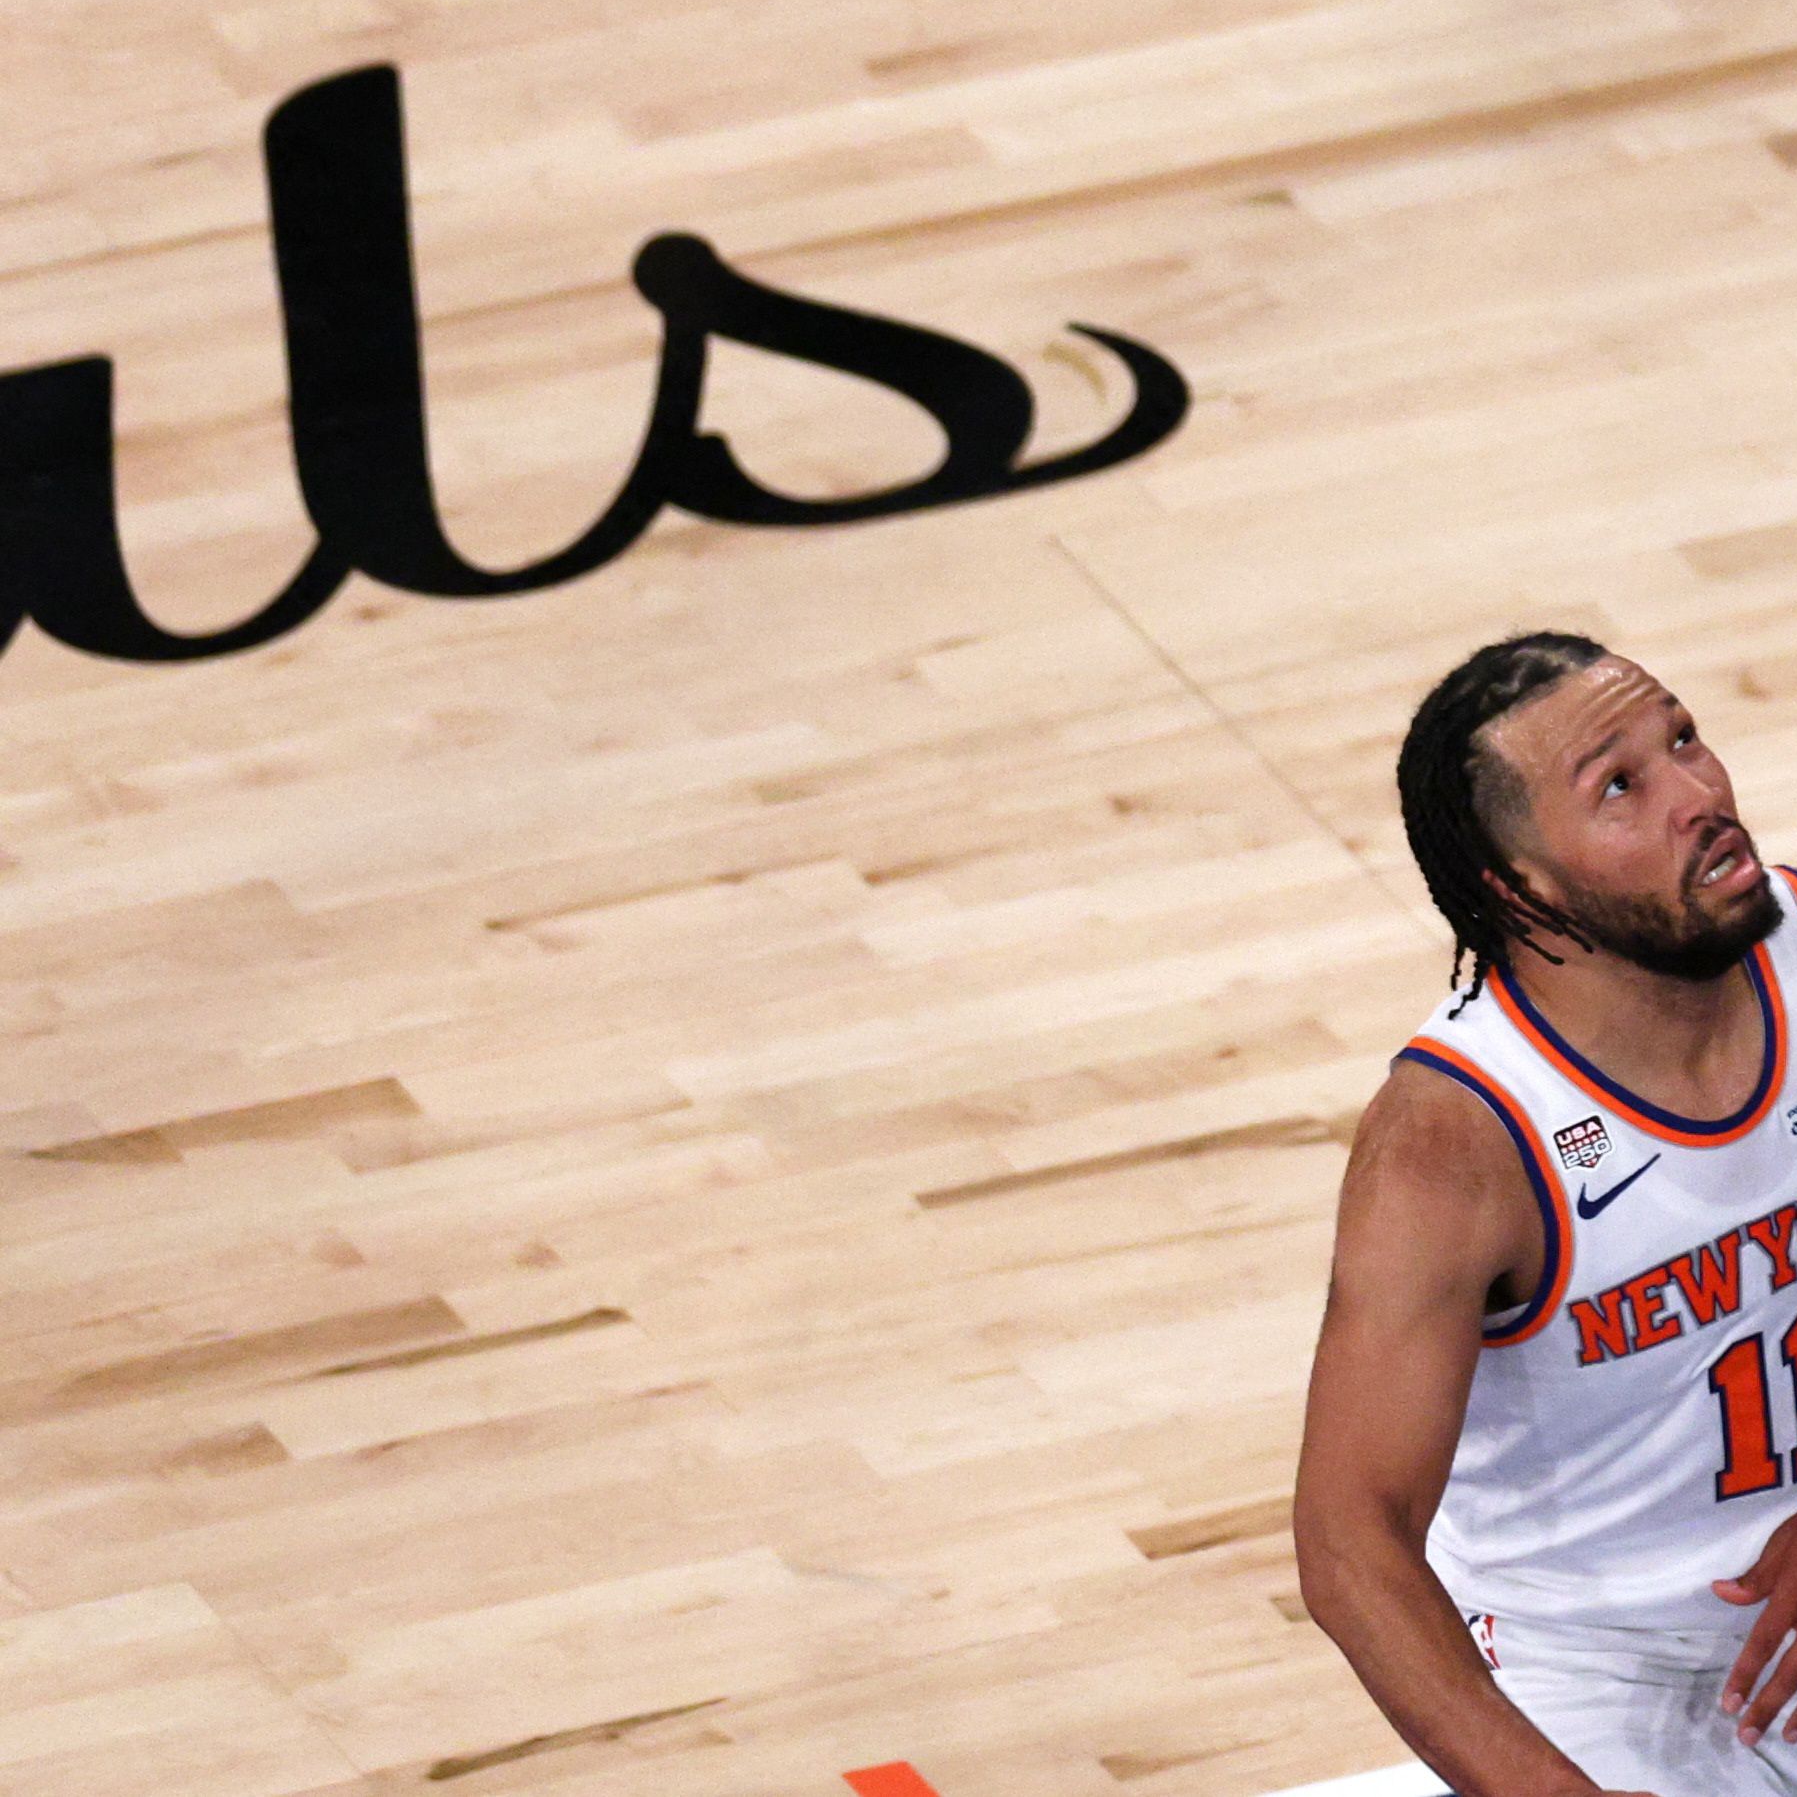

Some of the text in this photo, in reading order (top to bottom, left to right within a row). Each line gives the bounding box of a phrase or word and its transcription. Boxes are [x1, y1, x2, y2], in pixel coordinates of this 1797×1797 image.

[1556, 1121, 1602, 1146] USA
[1563, 1138, 1613, 1170] 250
[1568, 1226, 1743, 1368] NEW
